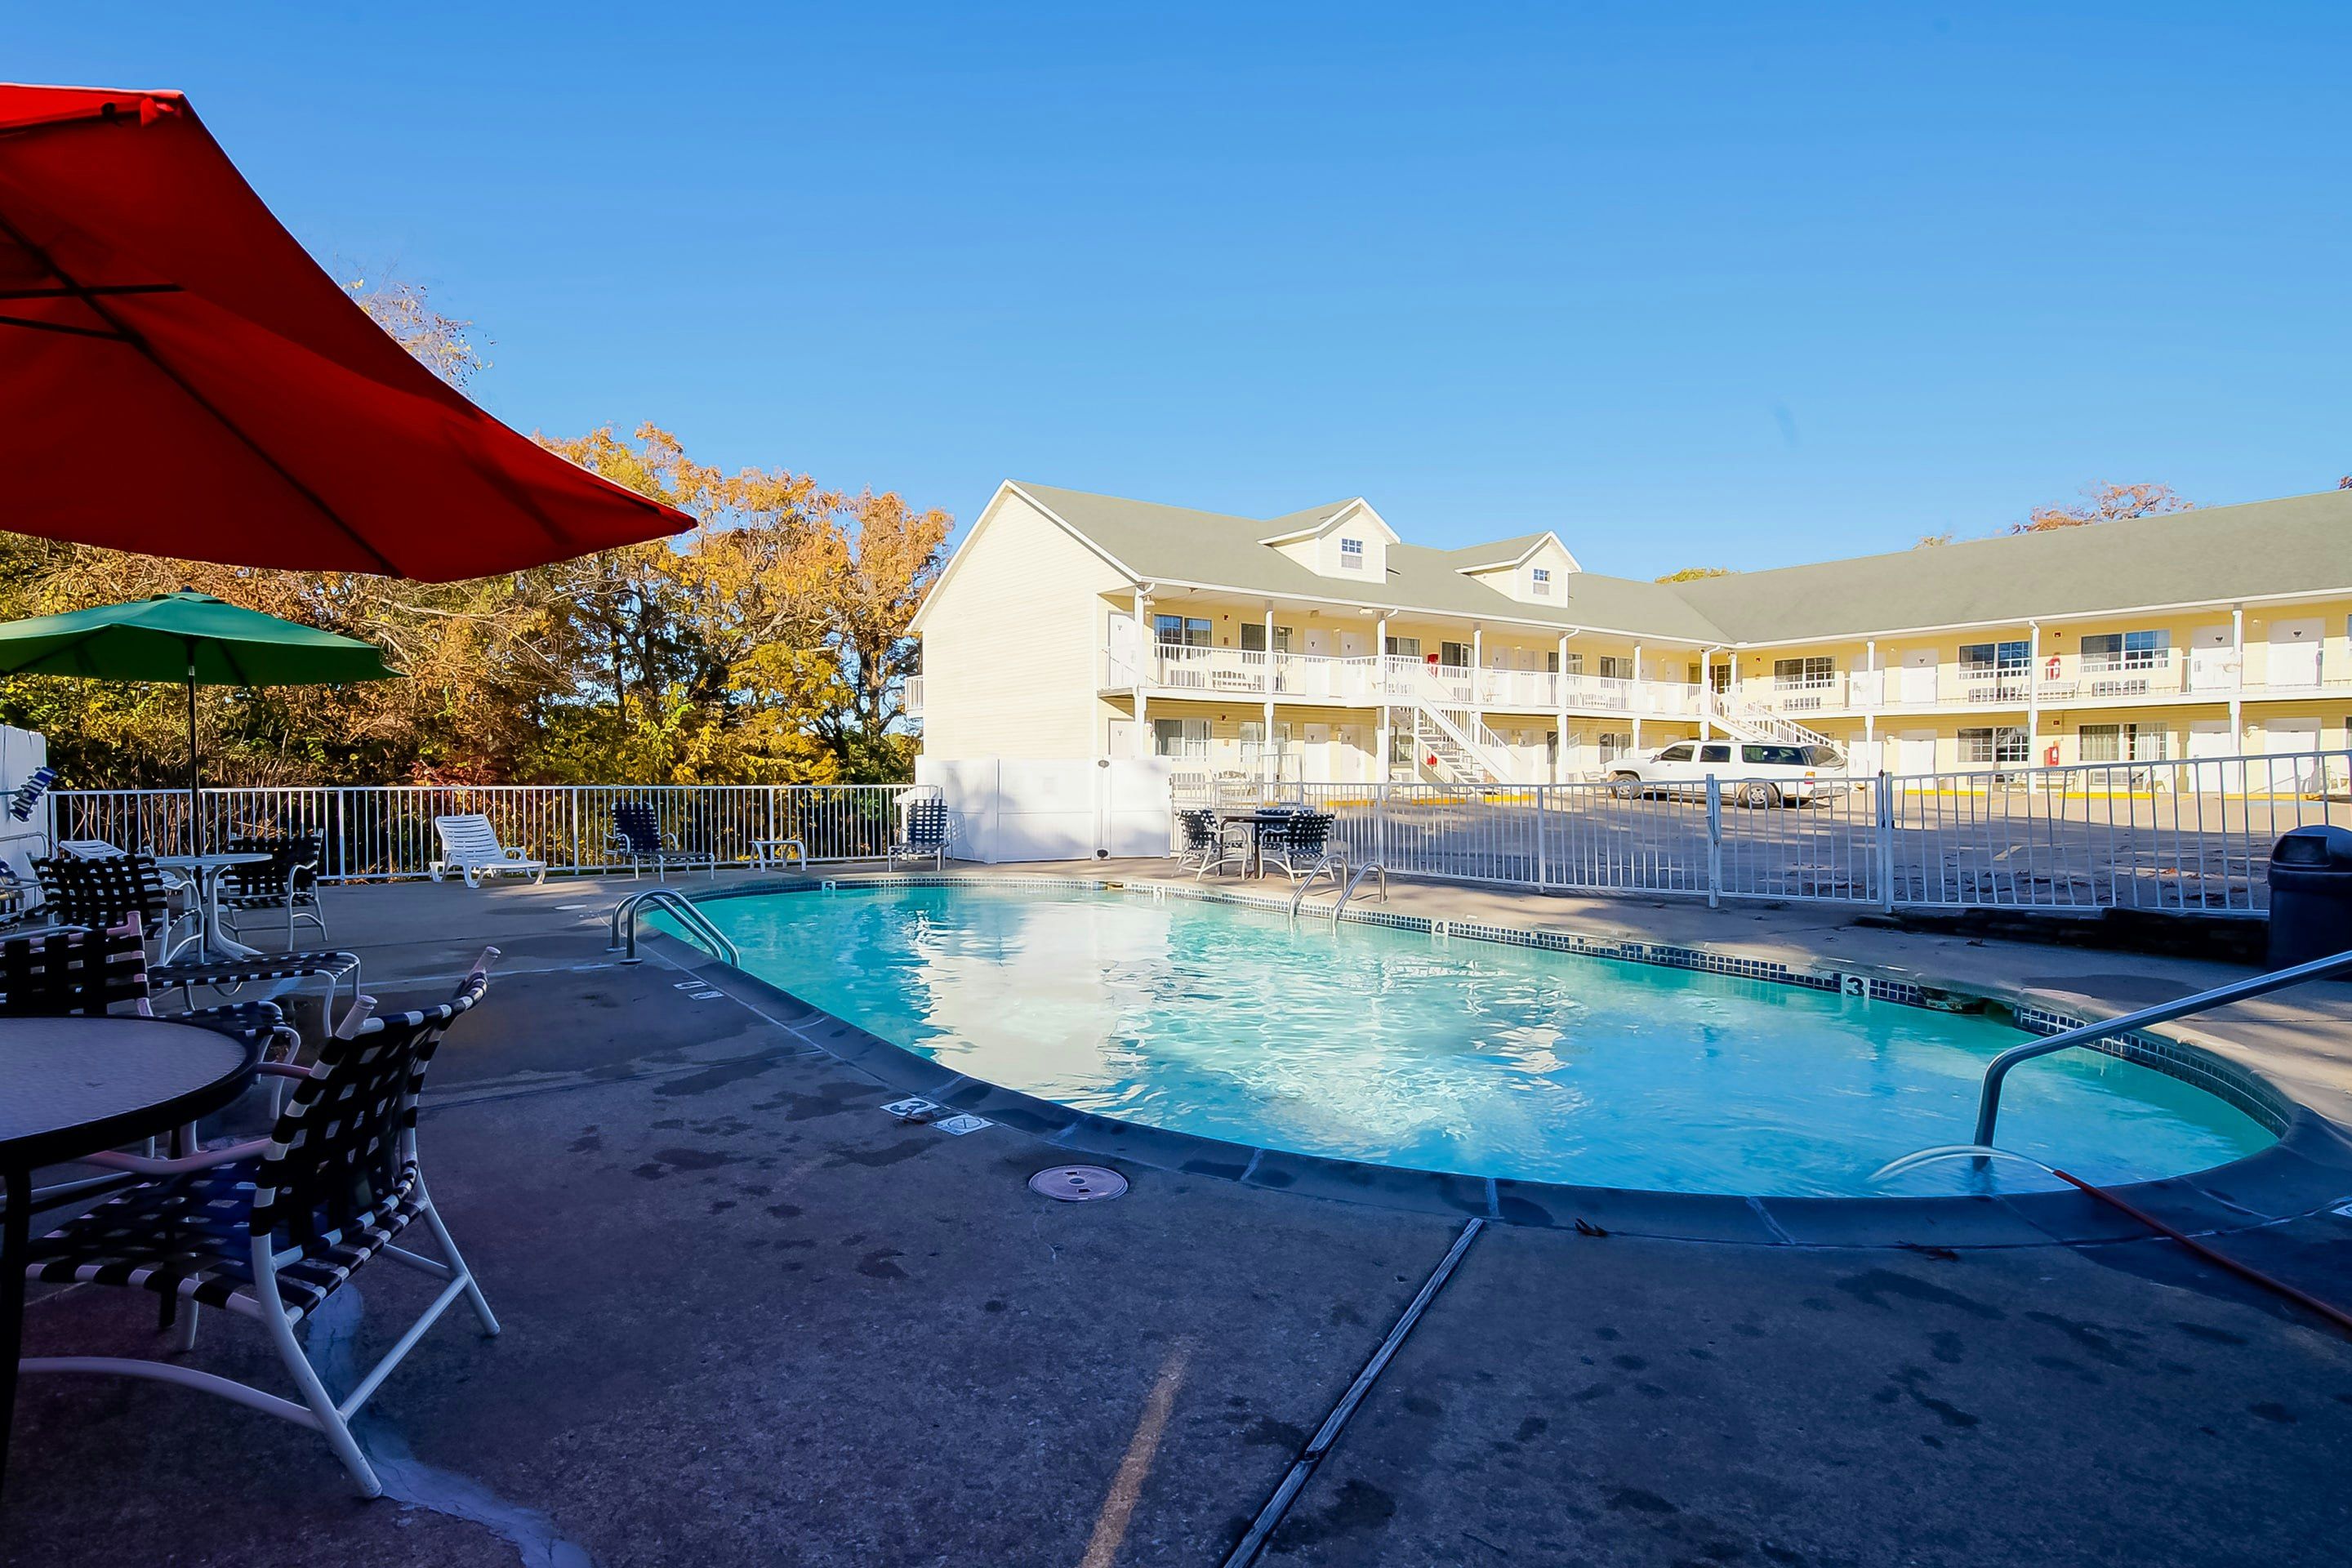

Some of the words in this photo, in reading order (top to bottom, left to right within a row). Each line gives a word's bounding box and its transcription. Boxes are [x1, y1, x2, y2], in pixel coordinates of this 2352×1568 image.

[1156, 886, 1162, 899] 5
[1435, 921, 1445, 933] 4
[1846, 977, 1865, 996] 3
